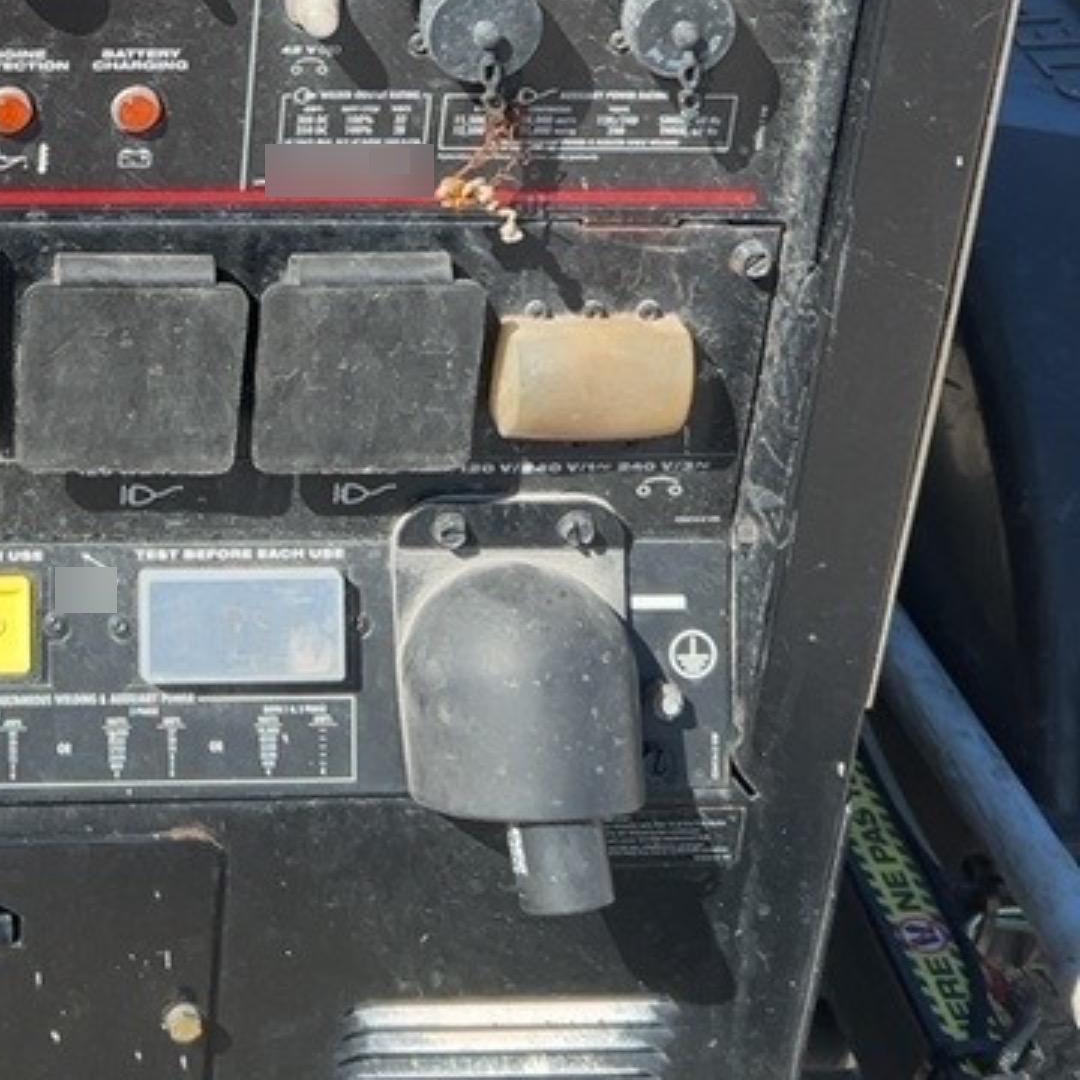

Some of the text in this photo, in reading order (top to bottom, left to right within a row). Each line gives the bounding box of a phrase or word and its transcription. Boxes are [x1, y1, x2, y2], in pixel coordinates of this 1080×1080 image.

[101, 48, 181, 60] BATTERY
[93, 60, 189, 72] CHARGING
[8, 550, 43, 561] USE
[134, 548, 345, 561] TEST BEFORE EACH USE
